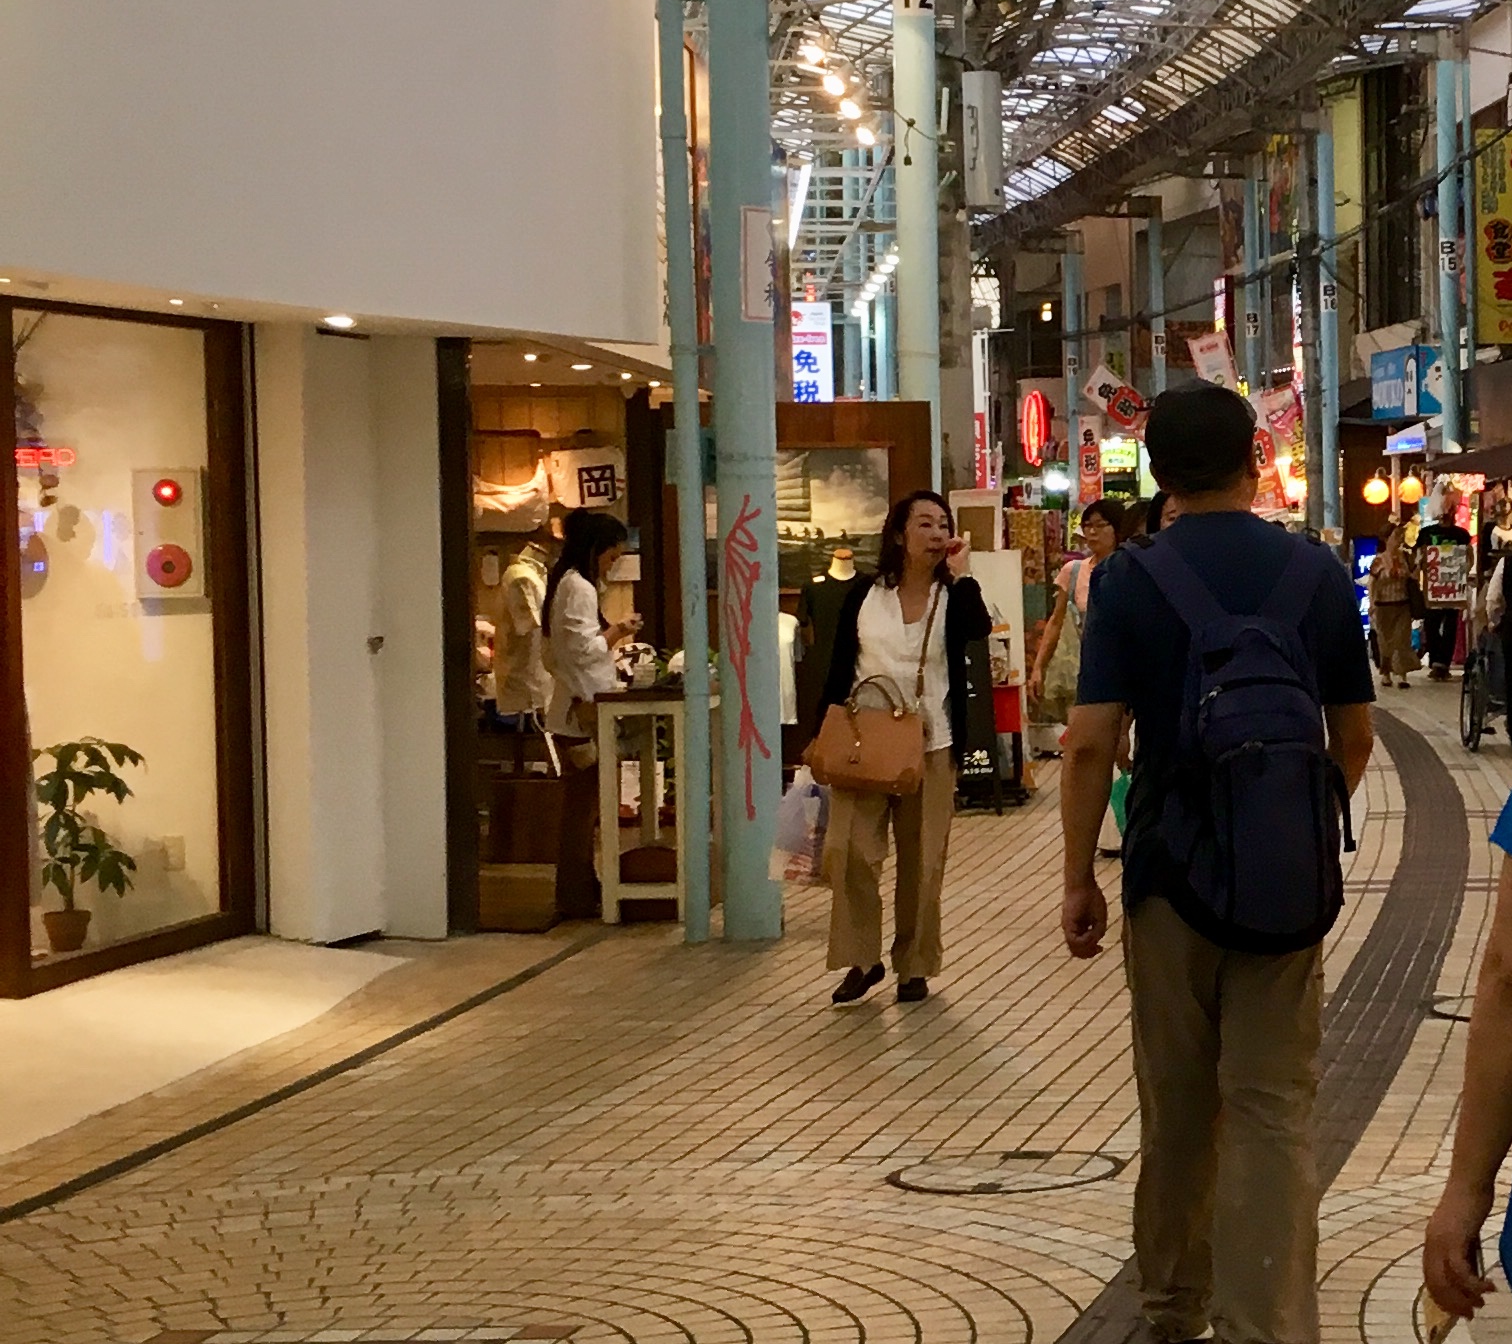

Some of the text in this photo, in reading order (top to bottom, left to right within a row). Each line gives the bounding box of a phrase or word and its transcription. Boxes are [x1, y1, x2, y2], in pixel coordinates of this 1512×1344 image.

[1440, 241, 1456, 256] B
[1440, 258, 1457, 272] 15
[1323, 284, 1336, 297] B
[793, 349, 821, 403] 免税
